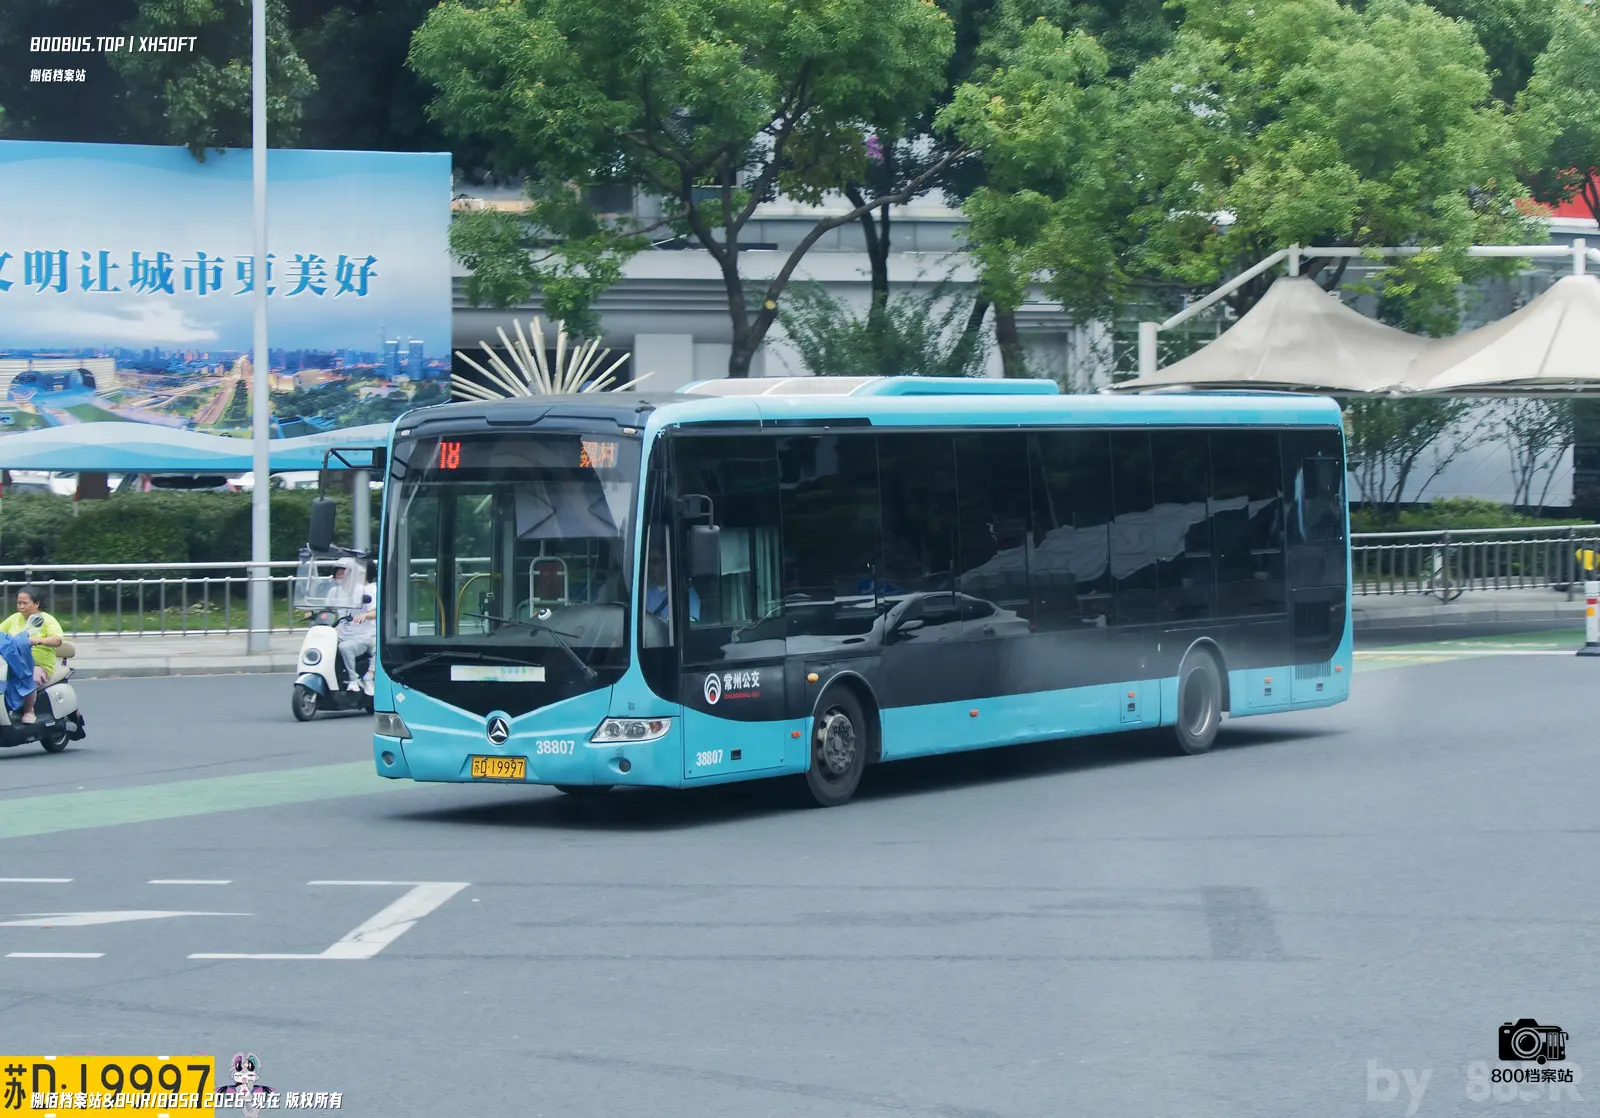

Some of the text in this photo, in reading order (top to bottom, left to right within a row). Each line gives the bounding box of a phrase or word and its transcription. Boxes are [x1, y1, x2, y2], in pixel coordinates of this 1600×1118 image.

[439, 441, 461, 470] 18
[723, 670, 760, 691] 常州公交
[535, 740, 576, 755] 38807
[695, 749, 723, 767] 38807
